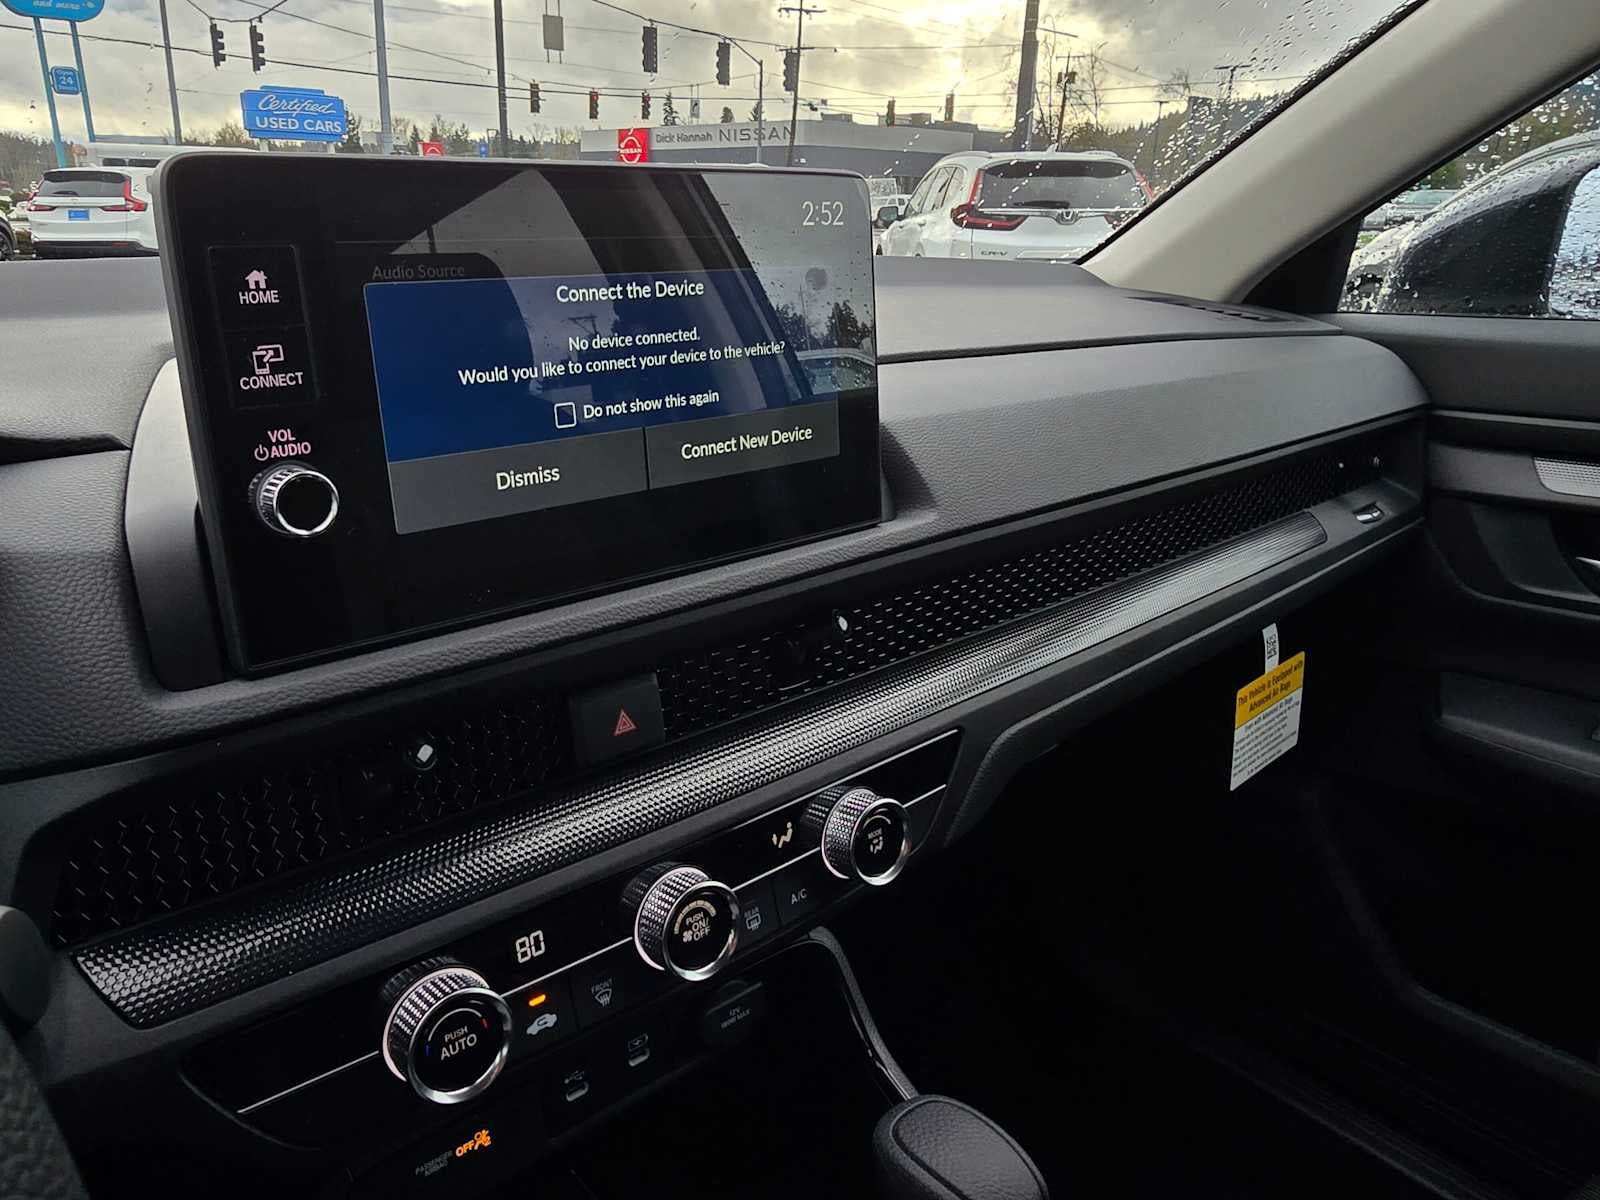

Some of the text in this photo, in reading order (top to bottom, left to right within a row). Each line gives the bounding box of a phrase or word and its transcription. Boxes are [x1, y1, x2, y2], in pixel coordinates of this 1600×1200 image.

[258, 94, 336, 116] Certified
[255, 116, 342, 133] USED CARS
[656, 126, 793, 143] Dick Hannah NISSAN
[802, 201, 844, 226] 2:52
[372, 264, 465, 280] Audio Source
[239, 290, 280, 305] HOME
[556, 280, 705, 303] Connect the Device
[569, 327, 700, 352] No device connected.
[458, 341, 785, 386] Would you like to connect your device to the vehicle?
[239, 371, 303, 390] CONNECT
[583, 390, 719, 419] Do not show this again
[267, 428, 296, 444] VOL
[681, 425, 813, 460] Connect New Device
[270, 441, 311, 459] AUDIO
[496, 466, 560, 491] Dismiss
[791, 888, 808, 905] A/C
[686, 912, 704, 926] PUSH
[693, 926, 711, 941] OFF
[515, 930, 546, 963] 80
[444, 1025, 468, 1043] PUSH
[440, 1033, 478, 1061] AUTO
[455, 1140, 475, 1157] OFF
